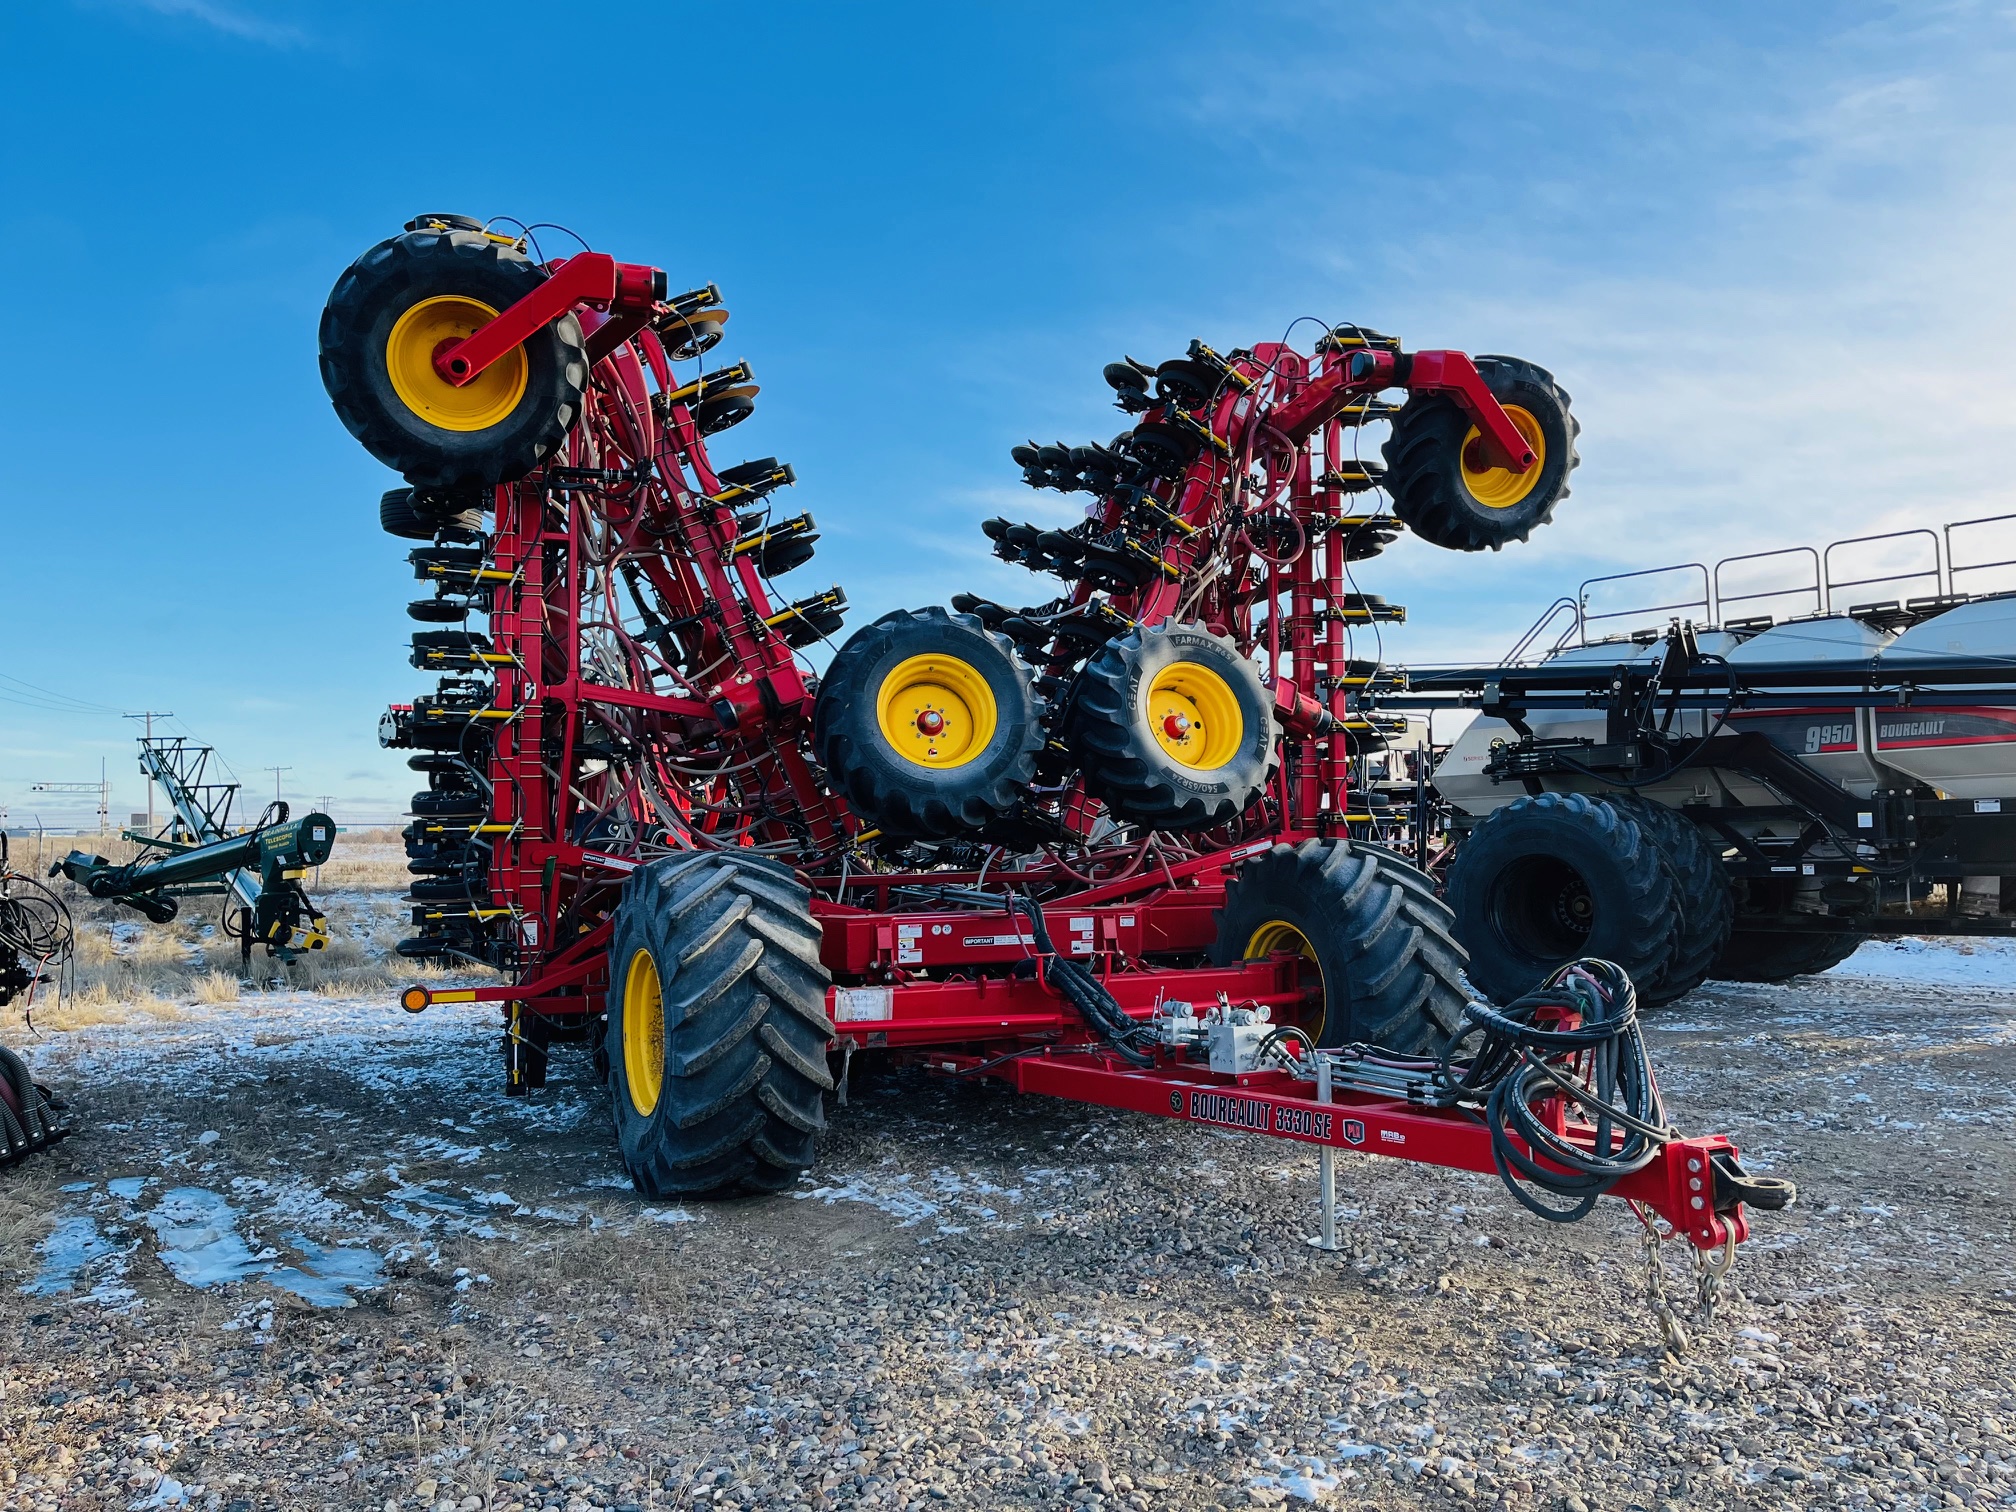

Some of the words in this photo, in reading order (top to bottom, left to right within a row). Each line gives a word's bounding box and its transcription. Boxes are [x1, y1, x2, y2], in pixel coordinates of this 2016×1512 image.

[1175, 635, 1213, 650] FARMAX
[1214, 646, 1232, 660] R65
[1128, 674, 1139, 711] CEAT
[1258, 716, 1269, 751] CEAT
[1805, 724, 1853, 753] 9950
[1880, 720, 1945, 738] BOURGAULT
[1172, 773, 1218, 793] 540/65R24
[265, 832, 293, 844] TELESCOPIC
[1190, 1092, 1271, 1130] BOURGAULT
[1275, 1106, 1312, 1135] 3330
[1313, 1113, 1332, 1139] SE
